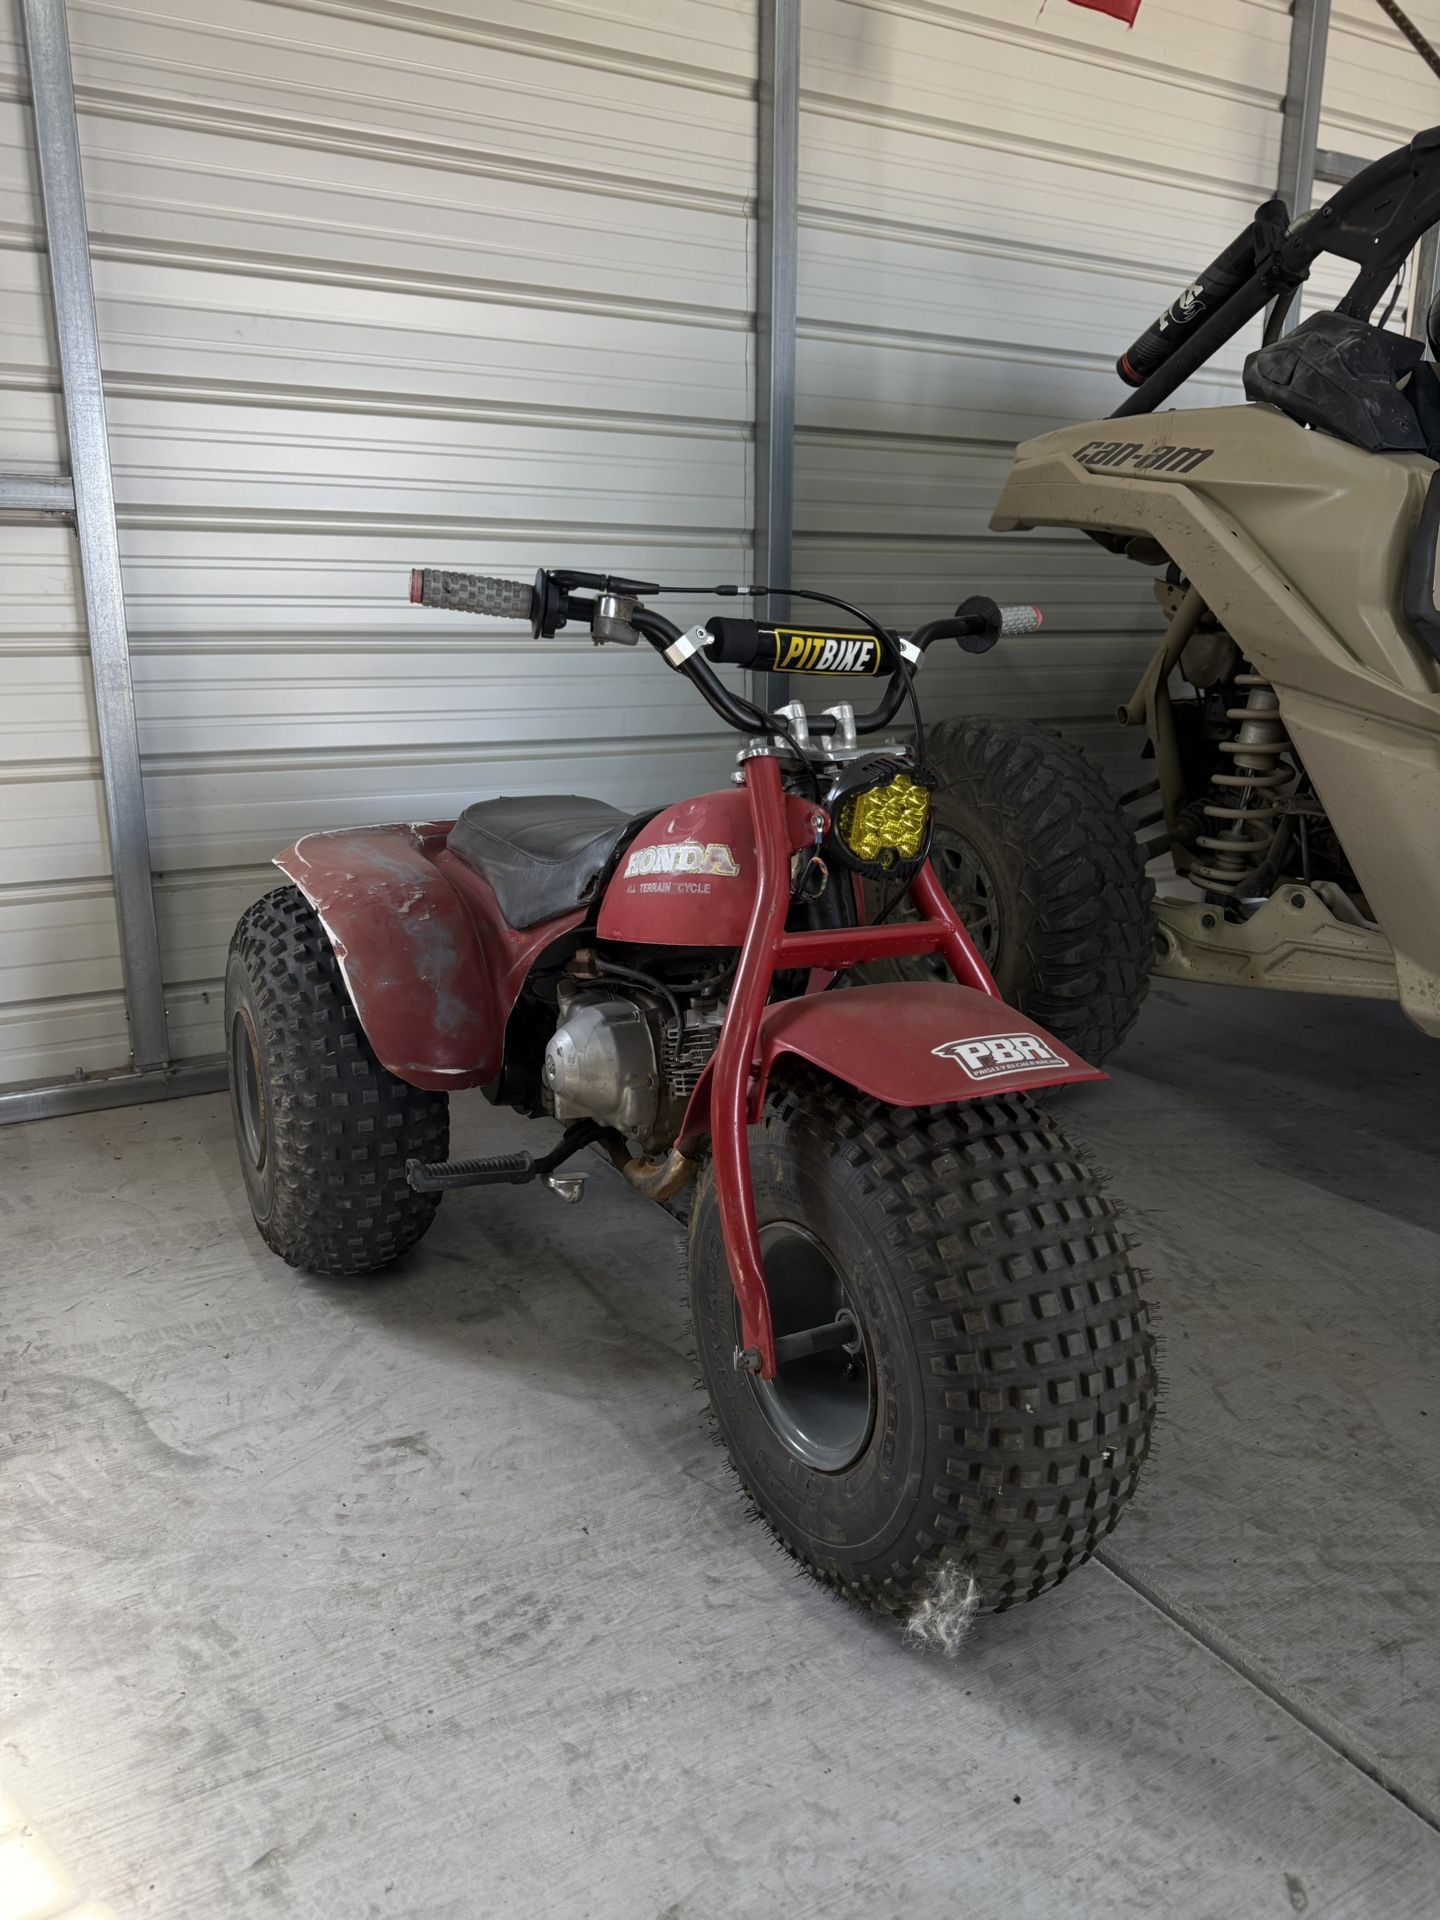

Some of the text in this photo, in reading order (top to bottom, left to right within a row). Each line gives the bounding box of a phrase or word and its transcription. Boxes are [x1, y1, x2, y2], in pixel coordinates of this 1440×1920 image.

[623, 842, 740, 879] HONDA
[640, 882, 672, 893] TERRAIN
[677, 882, 711, 894] CYCLE
[950, 1036, 1053, 1070] PBR
